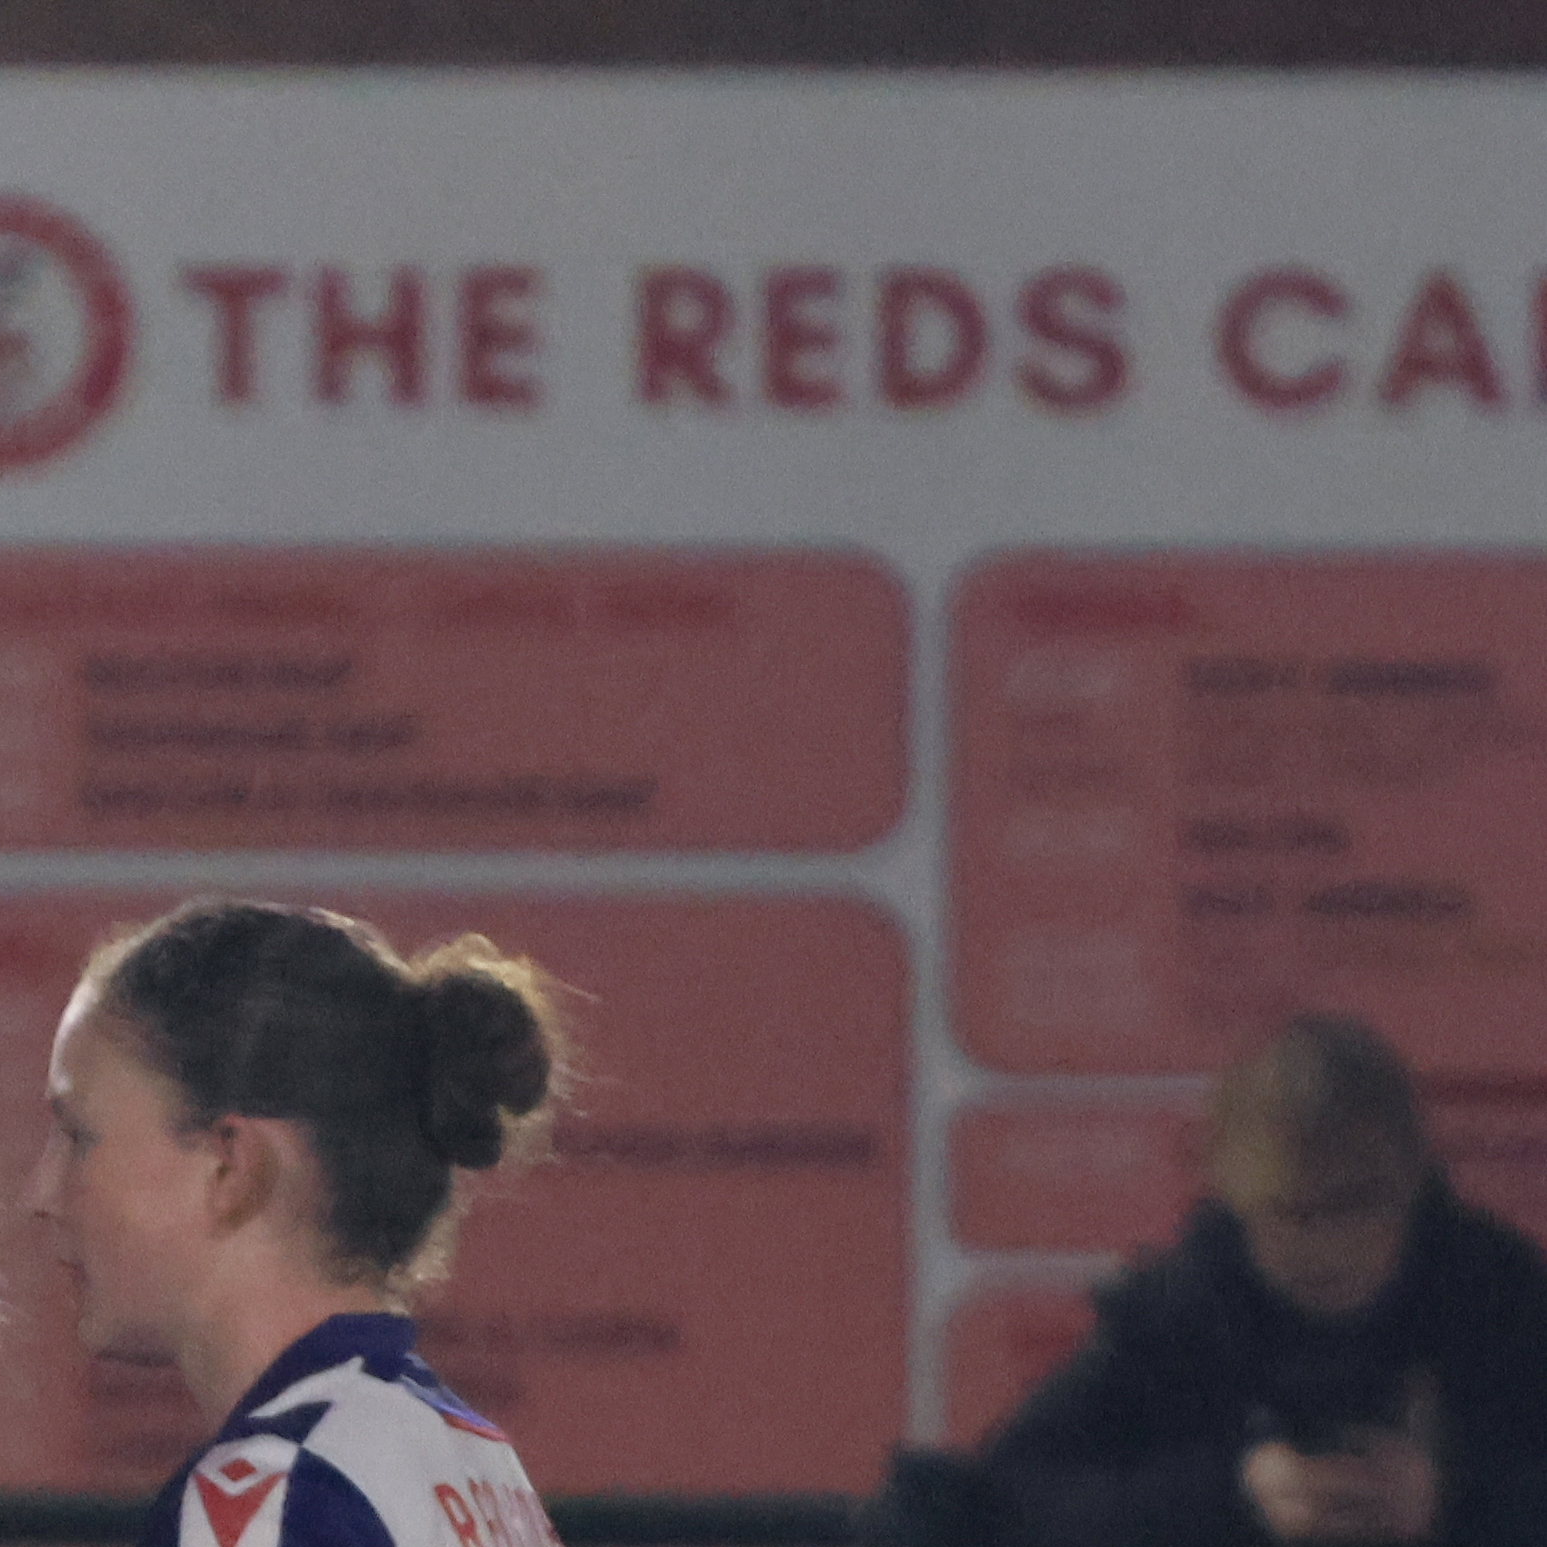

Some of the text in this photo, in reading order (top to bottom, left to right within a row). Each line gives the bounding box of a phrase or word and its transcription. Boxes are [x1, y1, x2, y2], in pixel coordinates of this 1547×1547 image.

[180, 266, 542, 408] THE
[638, 264, 1134, 414] REDS
[1216, 266, 1547, 416] CA
